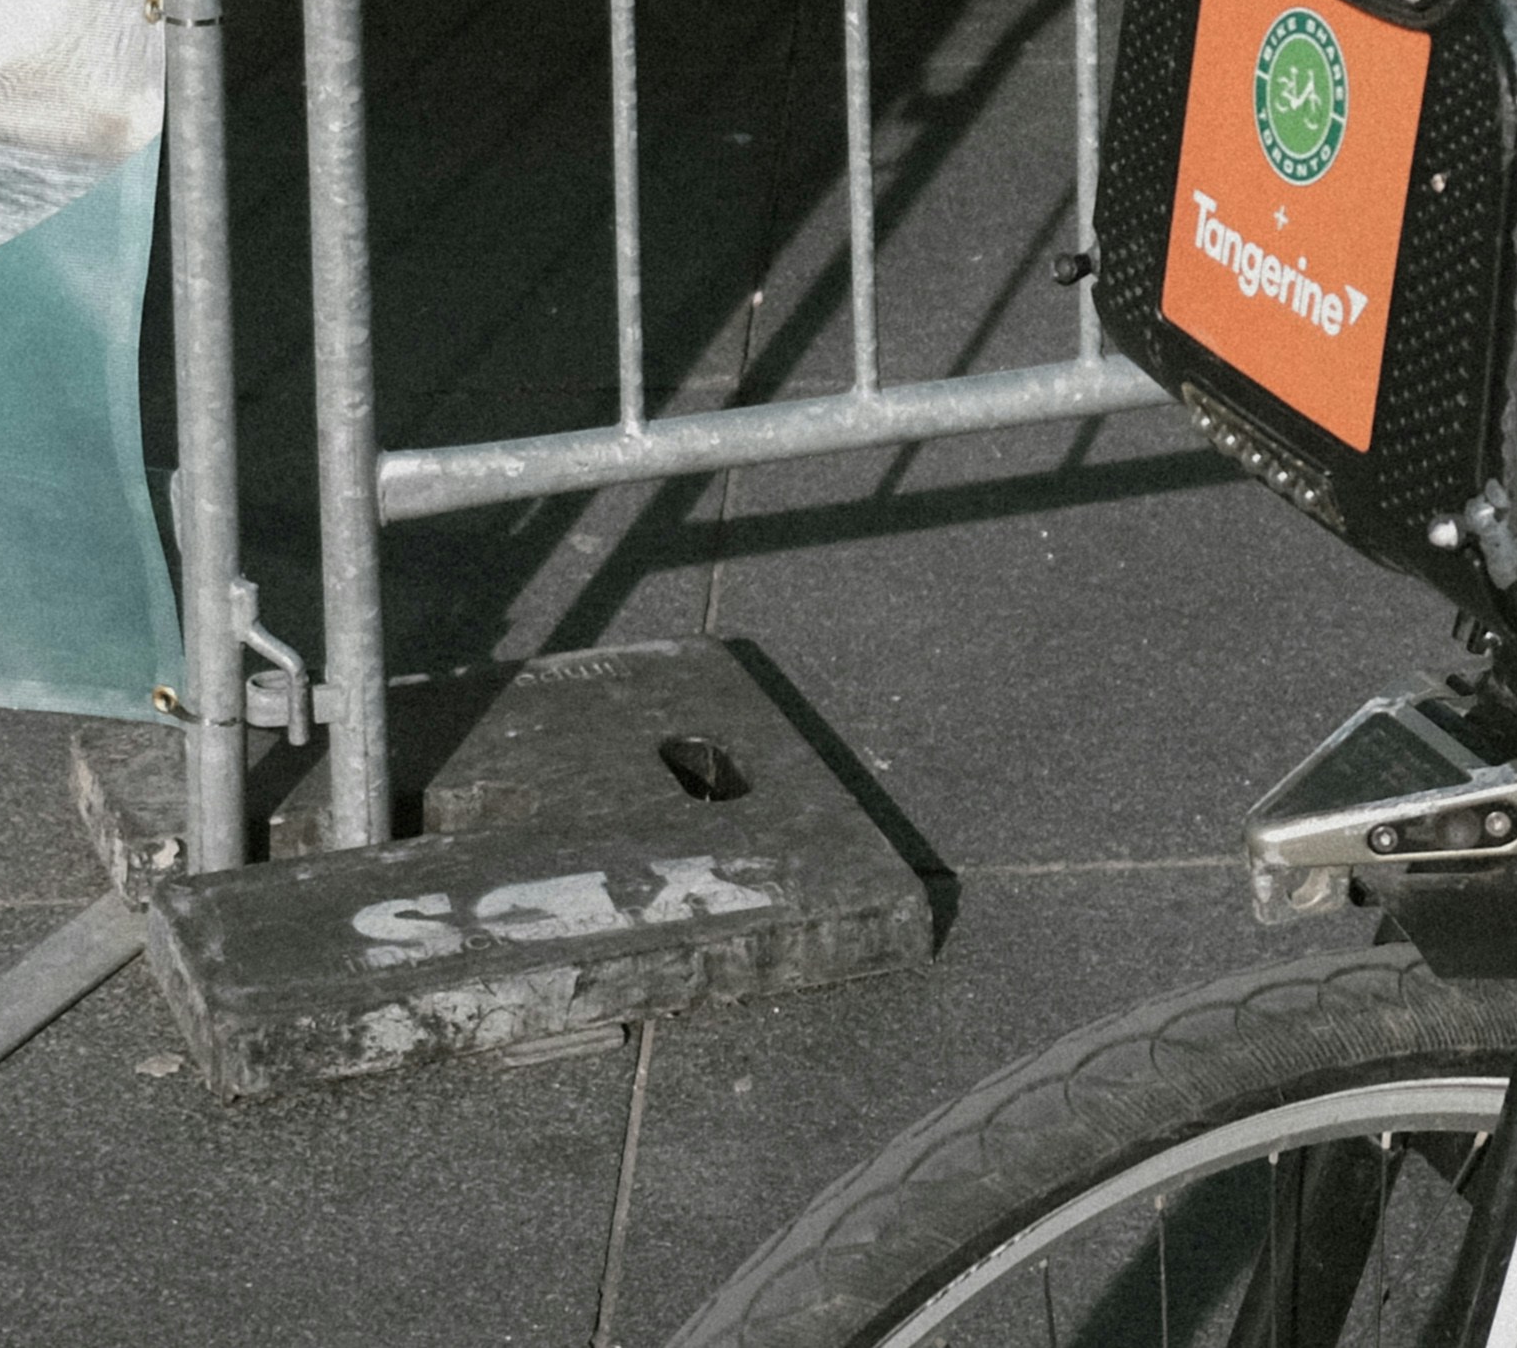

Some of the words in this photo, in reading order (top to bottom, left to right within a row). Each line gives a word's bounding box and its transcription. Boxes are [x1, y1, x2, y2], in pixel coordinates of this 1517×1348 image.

[1263, 14, 1299, 63] BIKE
[1305, 16, 1345, 102] SHARE
[1257, 109, 1333, 179] TORONTO
[1192, 189, 1345, 336] Tangerine
